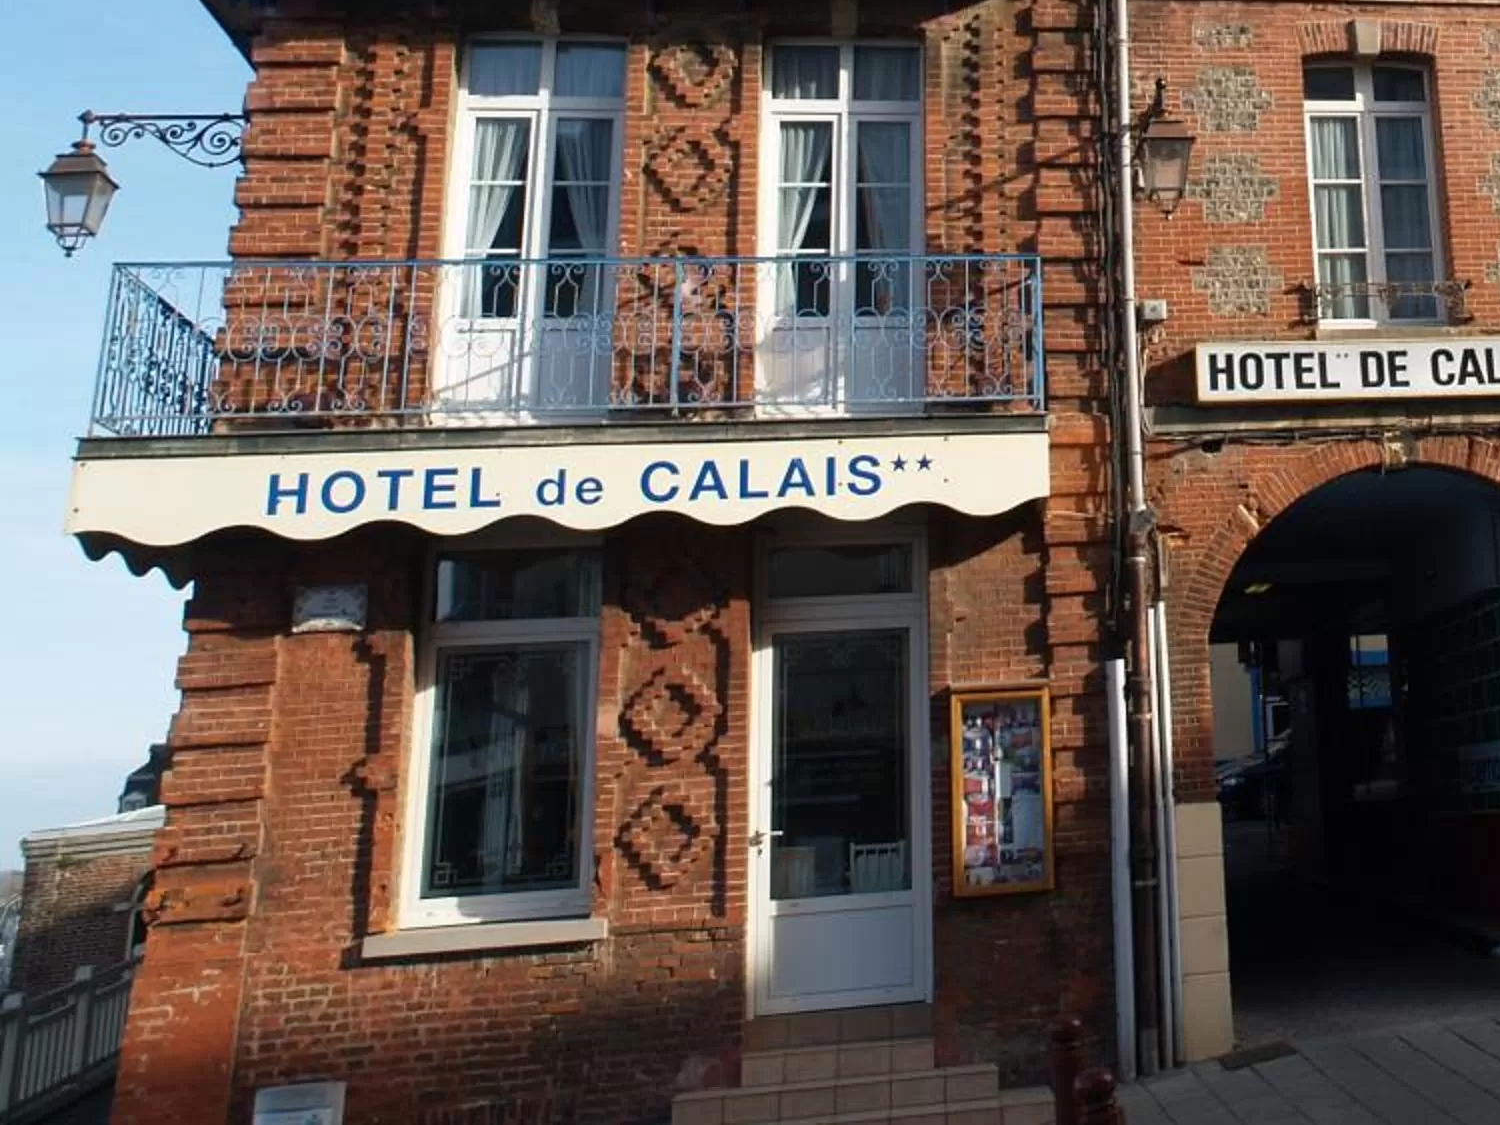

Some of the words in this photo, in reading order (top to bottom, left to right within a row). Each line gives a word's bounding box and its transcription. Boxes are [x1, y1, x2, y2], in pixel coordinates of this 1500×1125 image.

[1208, 350, 1341, 391] HOTEL
[1359, 349, 1410, 388] DE
[266, 466, 501, 516] HOTEL
[535, 468, 603, 506] de
[639, 453, 883, 502] CALAIS
